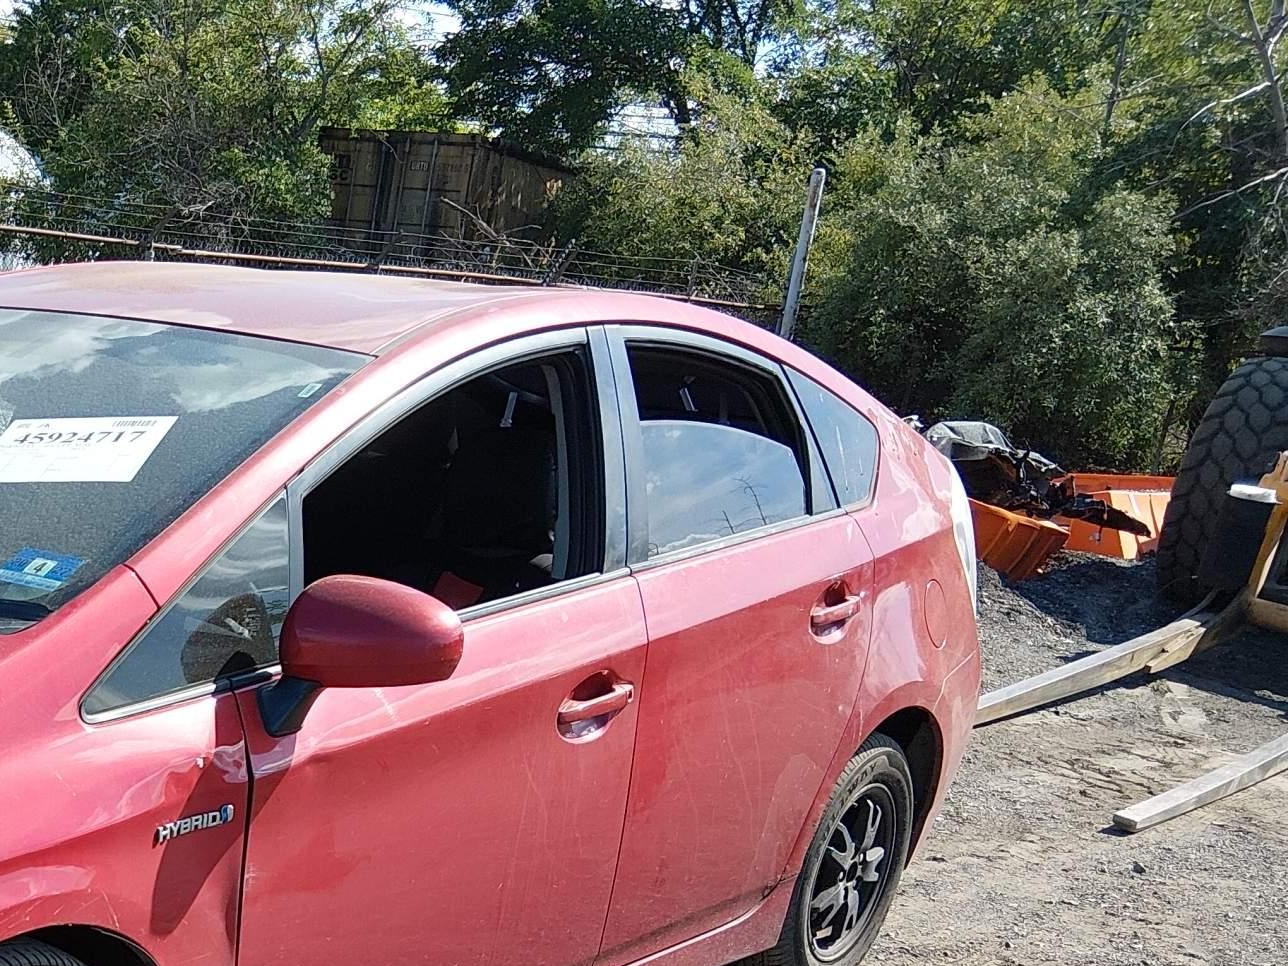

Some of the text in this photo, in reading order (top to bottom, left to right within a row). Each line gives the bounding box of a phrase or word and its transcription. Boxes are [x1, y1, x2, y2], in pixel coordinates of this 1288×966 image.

[14, 430, 147, 445] 45924717
[32, 562, 48, 574] 4
[156, 811, 221, 844] HYBRID
